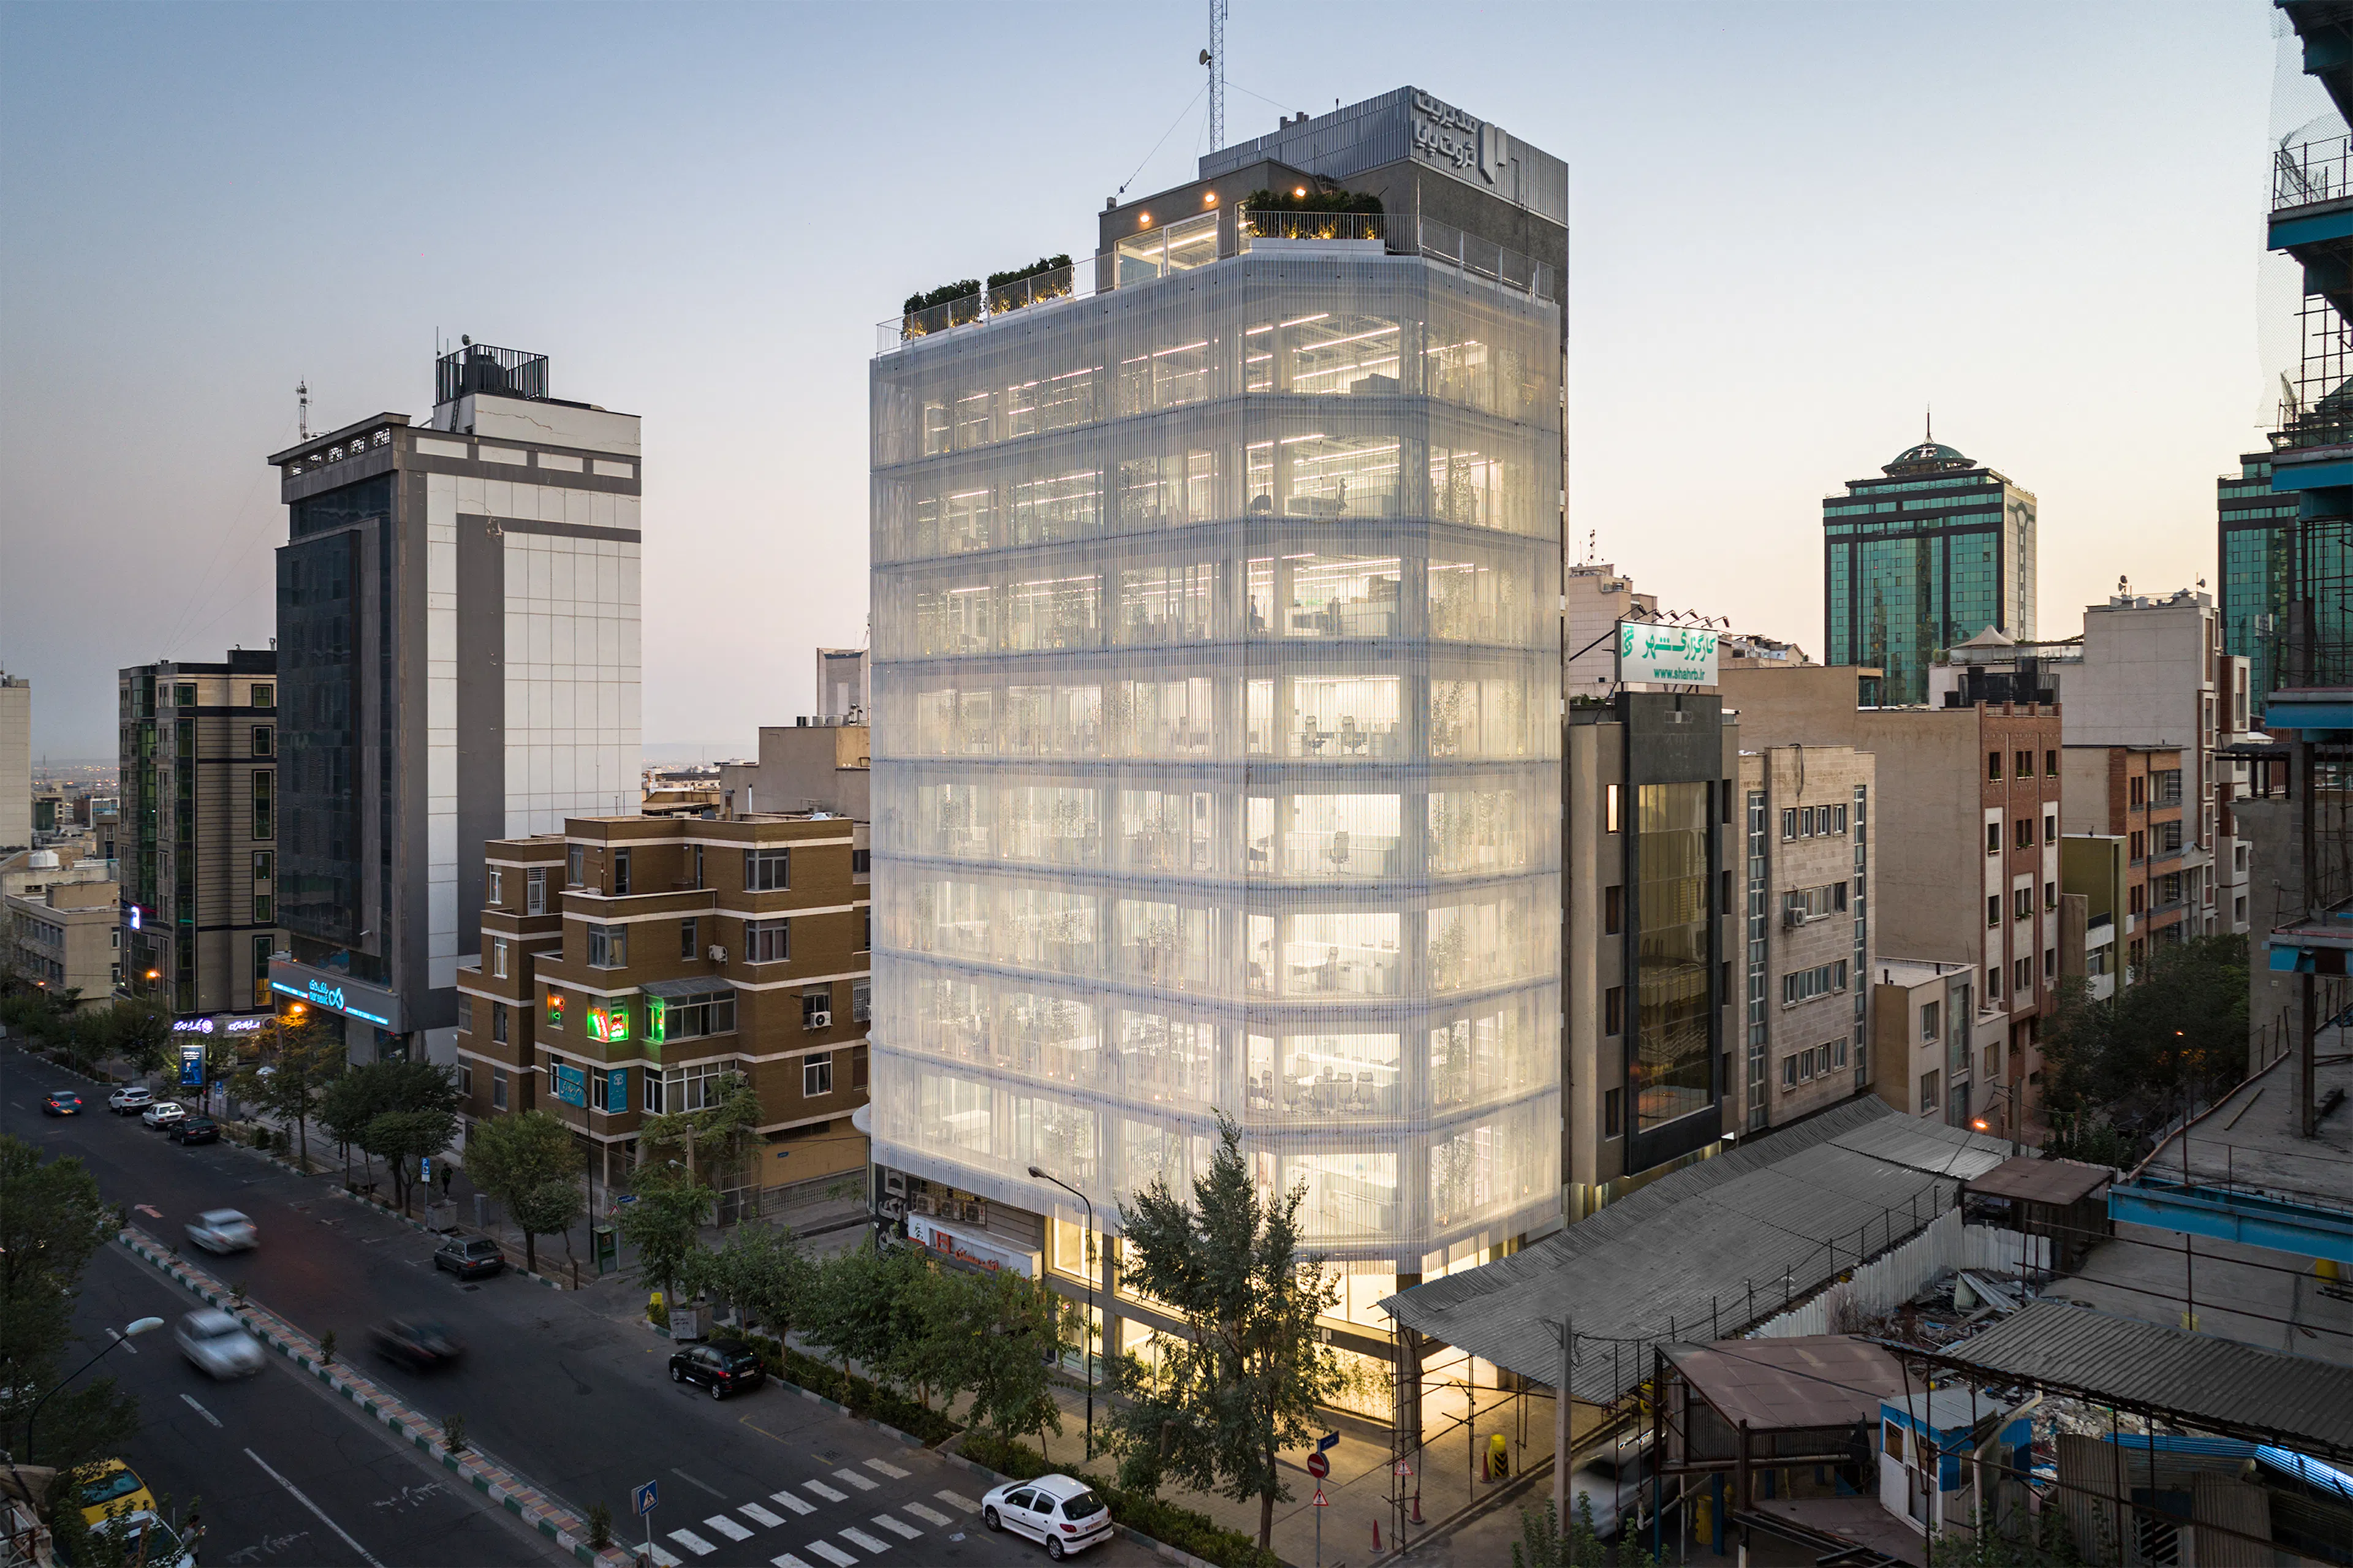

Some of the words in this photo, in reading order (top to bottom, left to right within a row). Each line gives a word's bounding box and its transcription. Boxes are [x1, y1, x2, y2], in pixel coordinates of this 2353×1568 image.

[1414, 89, 1476, 134] مدیریت
[1413, 118, 1438, 159] پایا
[1439, 134, 1476, 169] ثروت
[1642, 634, 1672, 660] شهر
[1672, 631, 1716, 662] کارگزاری
[1653, 667, 1705, 681] www.shahrb.ir
